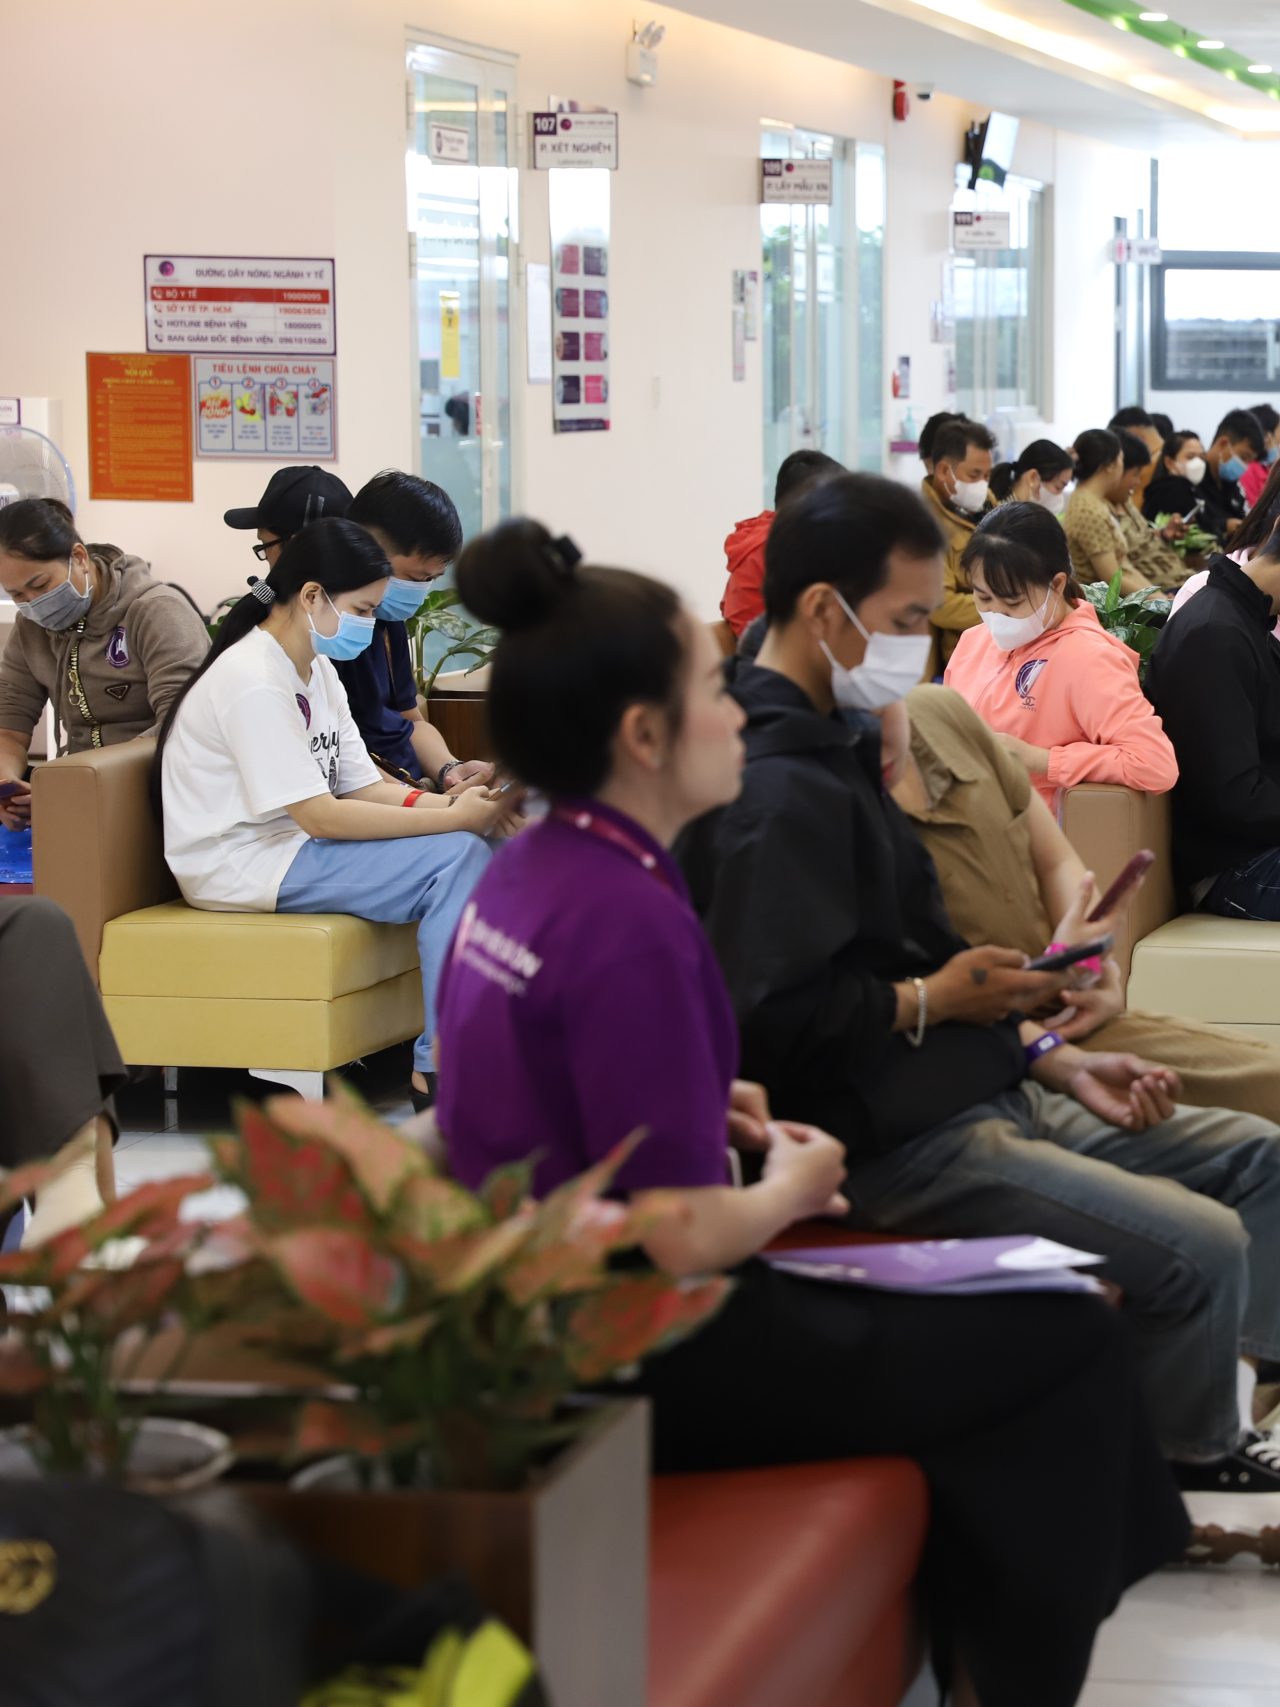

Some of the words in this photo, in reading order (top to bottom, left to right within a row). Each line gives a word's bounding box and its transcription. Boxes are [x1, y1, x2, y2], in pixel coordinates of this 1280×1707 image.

[535, 117, 556, 132] 107
[550, 142, 569, 153] XÉT
[572, 141, 611, 154] NGHIỆM
[195, 265, 226, 279] ĐƯỜNG
[228, 265, 245, 278] DÂY
[247, 266, 272, 279] NÓNG
[273, 267, 304, 280] NGÀNH
[306, 269, 313, 280] Y
[314, 267, 325, 280] TẾ
[165, 288, 178, 300] BỘ
[180, 290, 188, 299] Y
[190, 288, 198, 300] TẾ
[166, 302, 178, 313] SỞ
[180, 304, 187, 313] Y
[188, 302, 197, 313] TẾ
[212, 305, 232, 314] HCM
[166, 319, 202, 329] HOTLINE
[203, 318, 227, 330] BỆNH
[228, 318, 247, 330] VIỆN
[167, 335, 184, 343] BAN
[187, 333, 208, 343] GIÁM
[210, 332, 228, 344] ĐỐC
[230, 333, 253, 345] BỆNH
[255, 333, 273, 345] VIỆN
[236, 363, 261, 375] LỆNH
[264, 363, 289, 375] CHỮA
[292, 363, 318, 375] CHÁY
